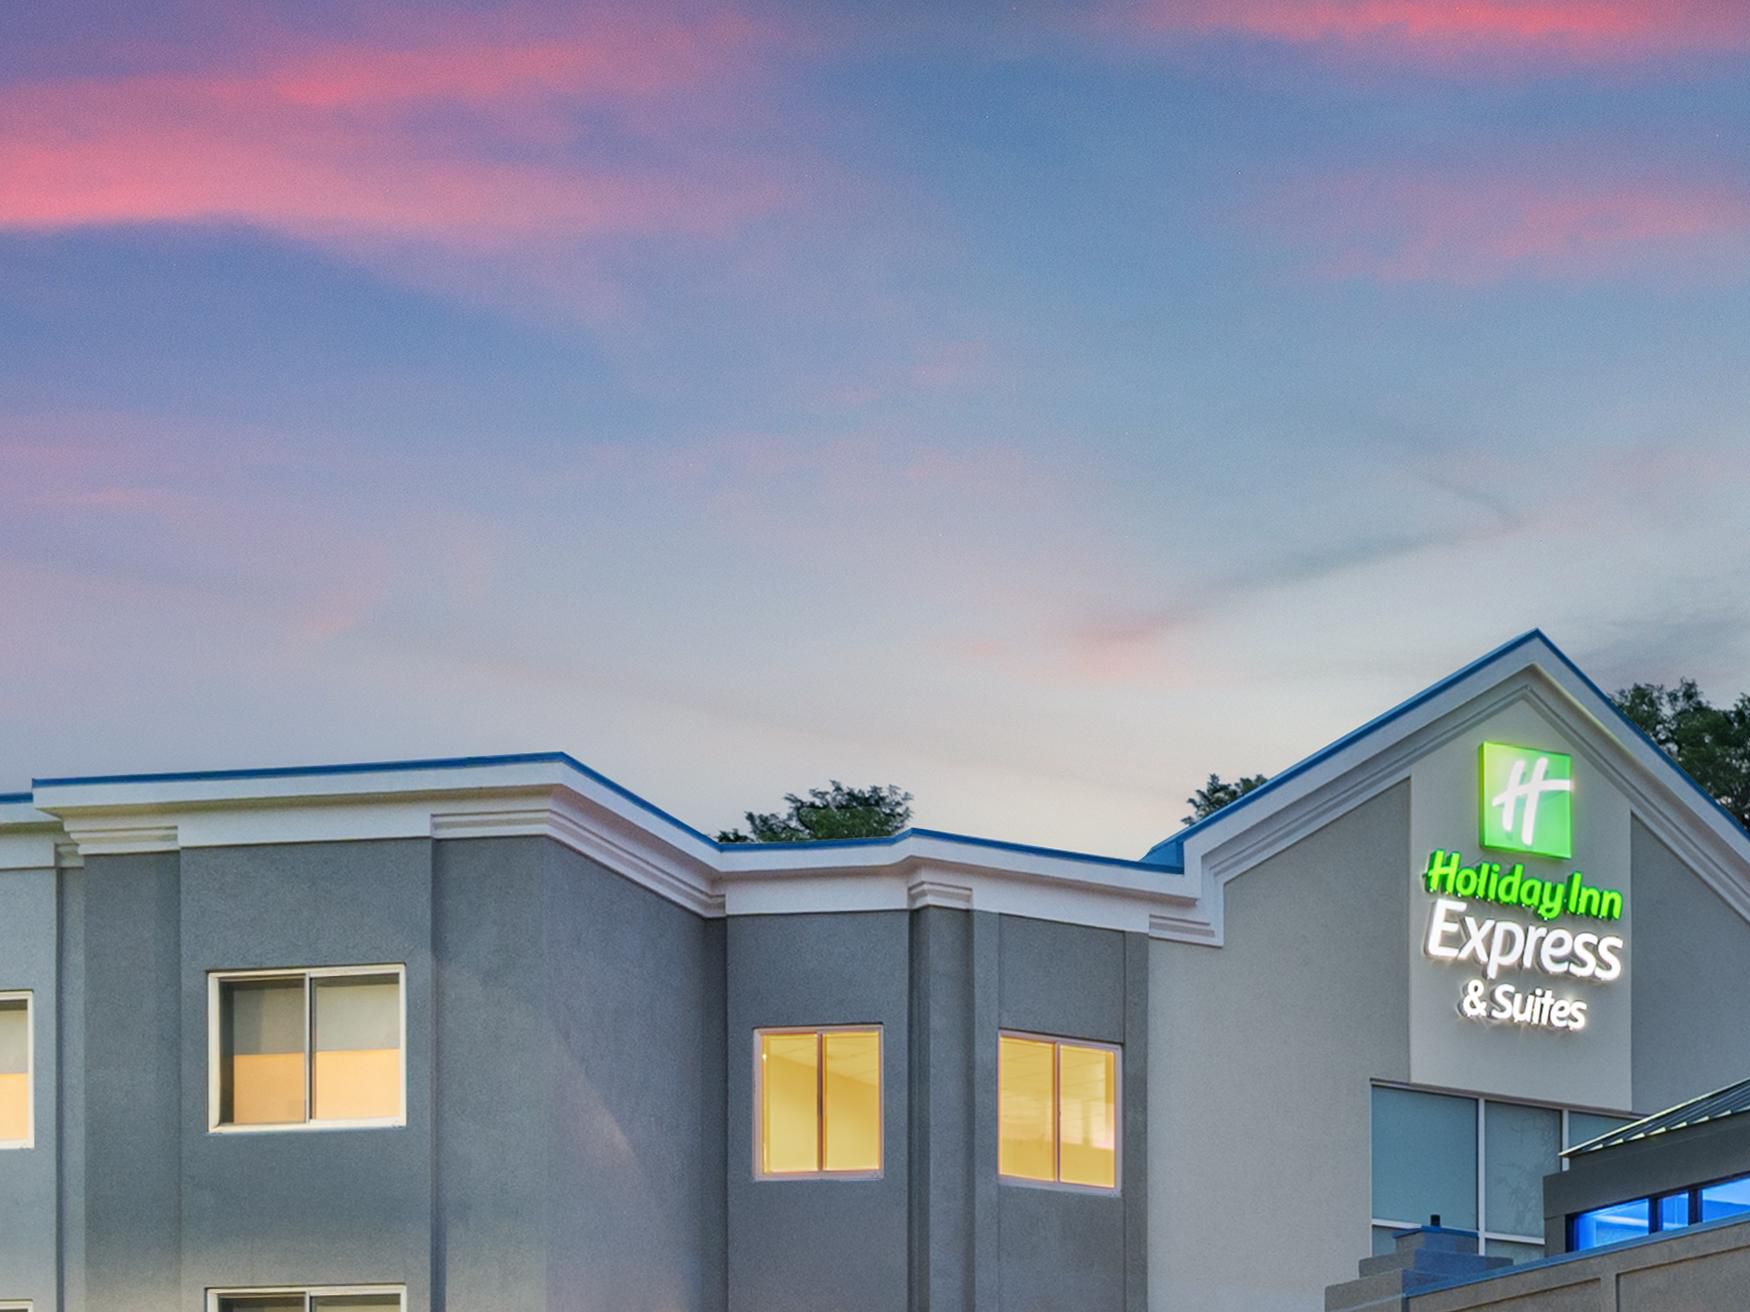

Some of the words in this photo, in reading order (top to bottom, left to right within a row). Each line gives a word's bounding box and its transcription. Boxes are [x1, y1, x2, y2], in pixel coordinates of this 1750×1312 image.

[1492, 757, 1574, 847] H
[1425, 849, 1565, 920] Holiday
[1566, 871, 1623, 920] Inn
[1426, 897, 1624, 982] Express
[1461, 979, 1487, 1018] &
[1491, 983, 1588, 1030] Suites
